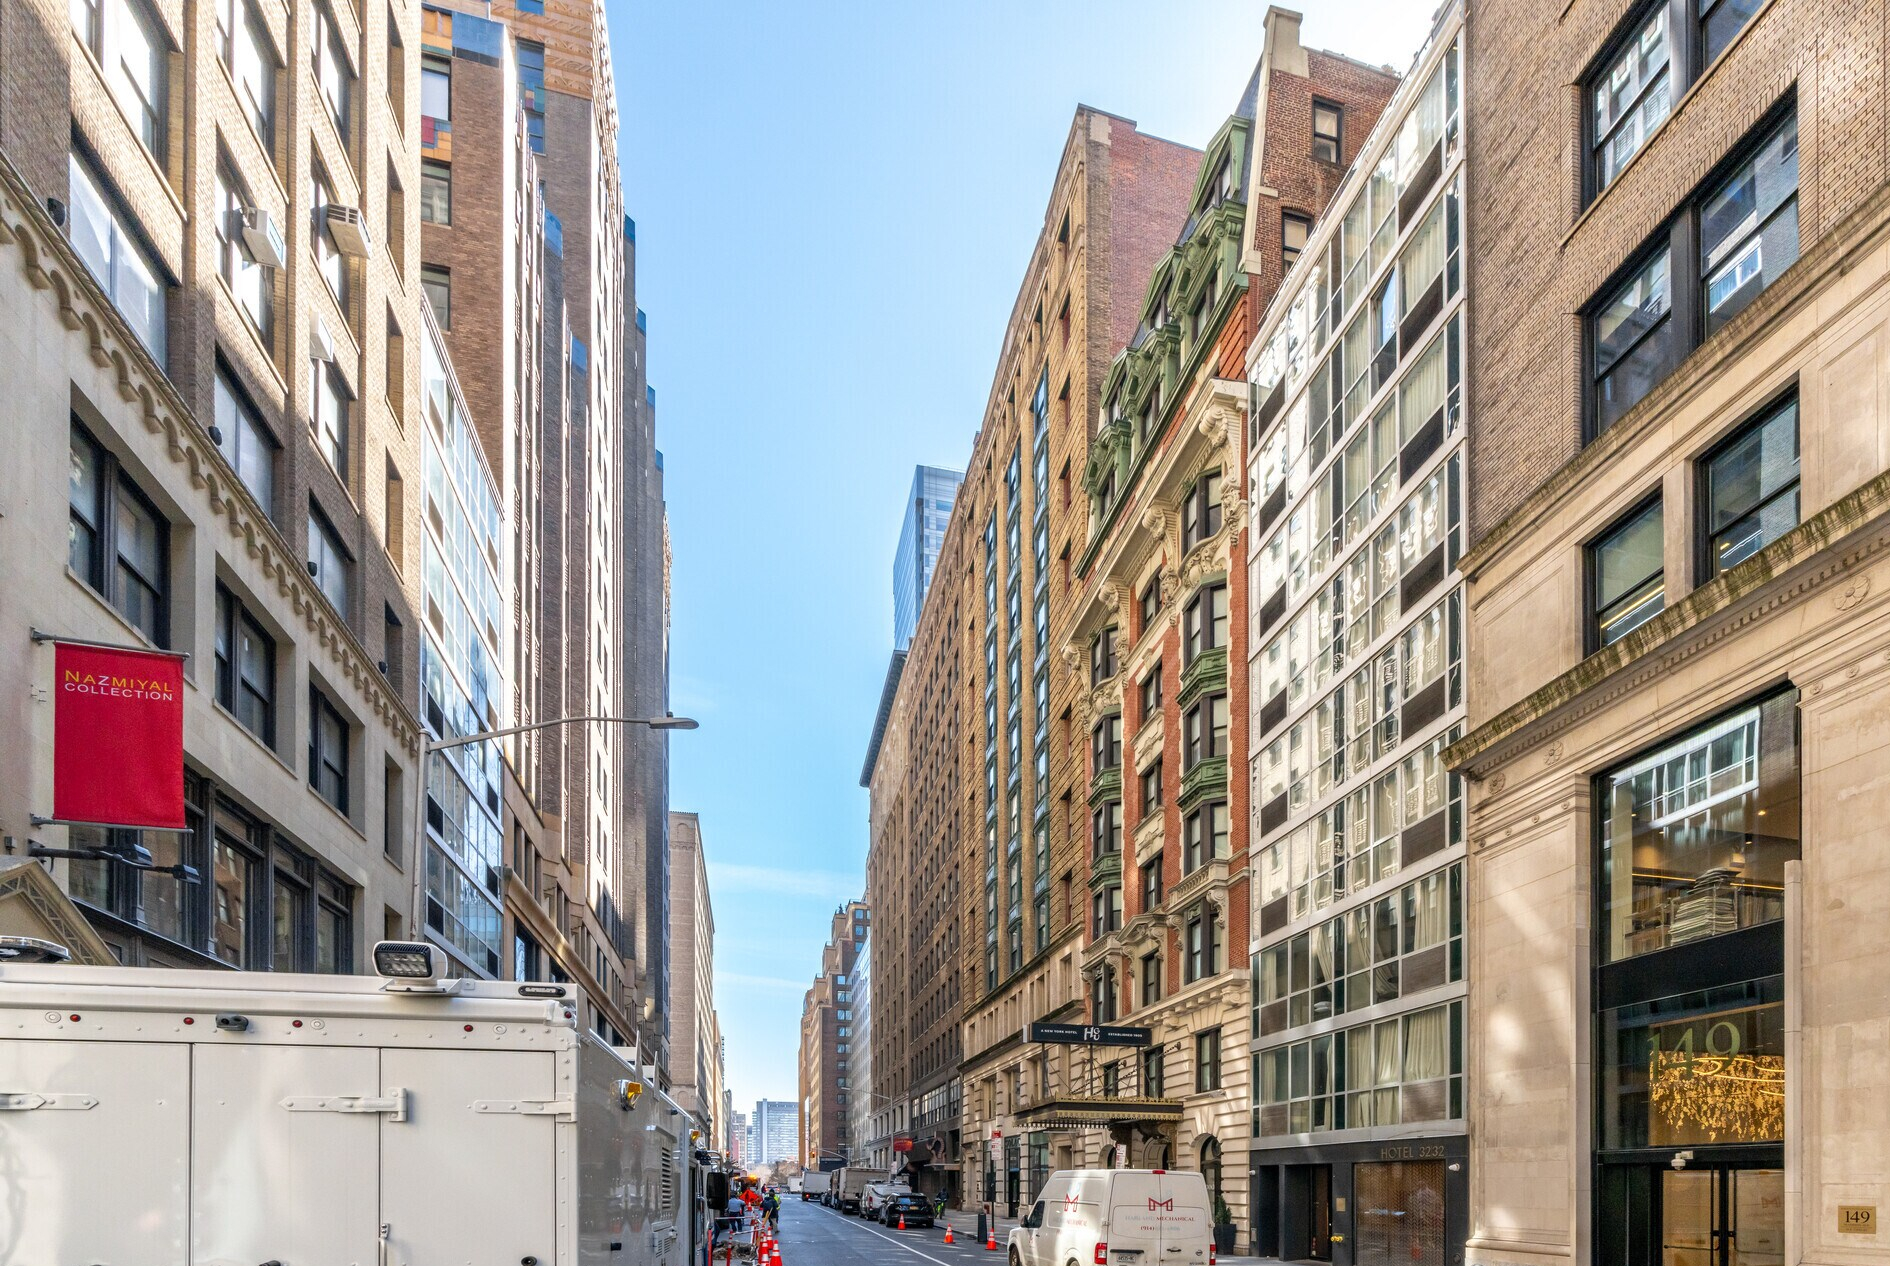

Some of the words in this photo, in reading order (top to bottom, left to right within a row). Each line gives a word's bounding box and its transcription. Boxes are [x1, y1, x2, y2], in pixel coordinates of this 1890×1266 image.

[65, 670, 173, 692] NAZMIYAL
[64, 683, 173, 701] COLLECTION
[1647, 1021, 1741, 1082] 149
[1381, 1147, 1414, 1159] HOTEL
[1419, 1145, 1445, 1158] 3232
[1846, 1210, 1870, 1223] 149
